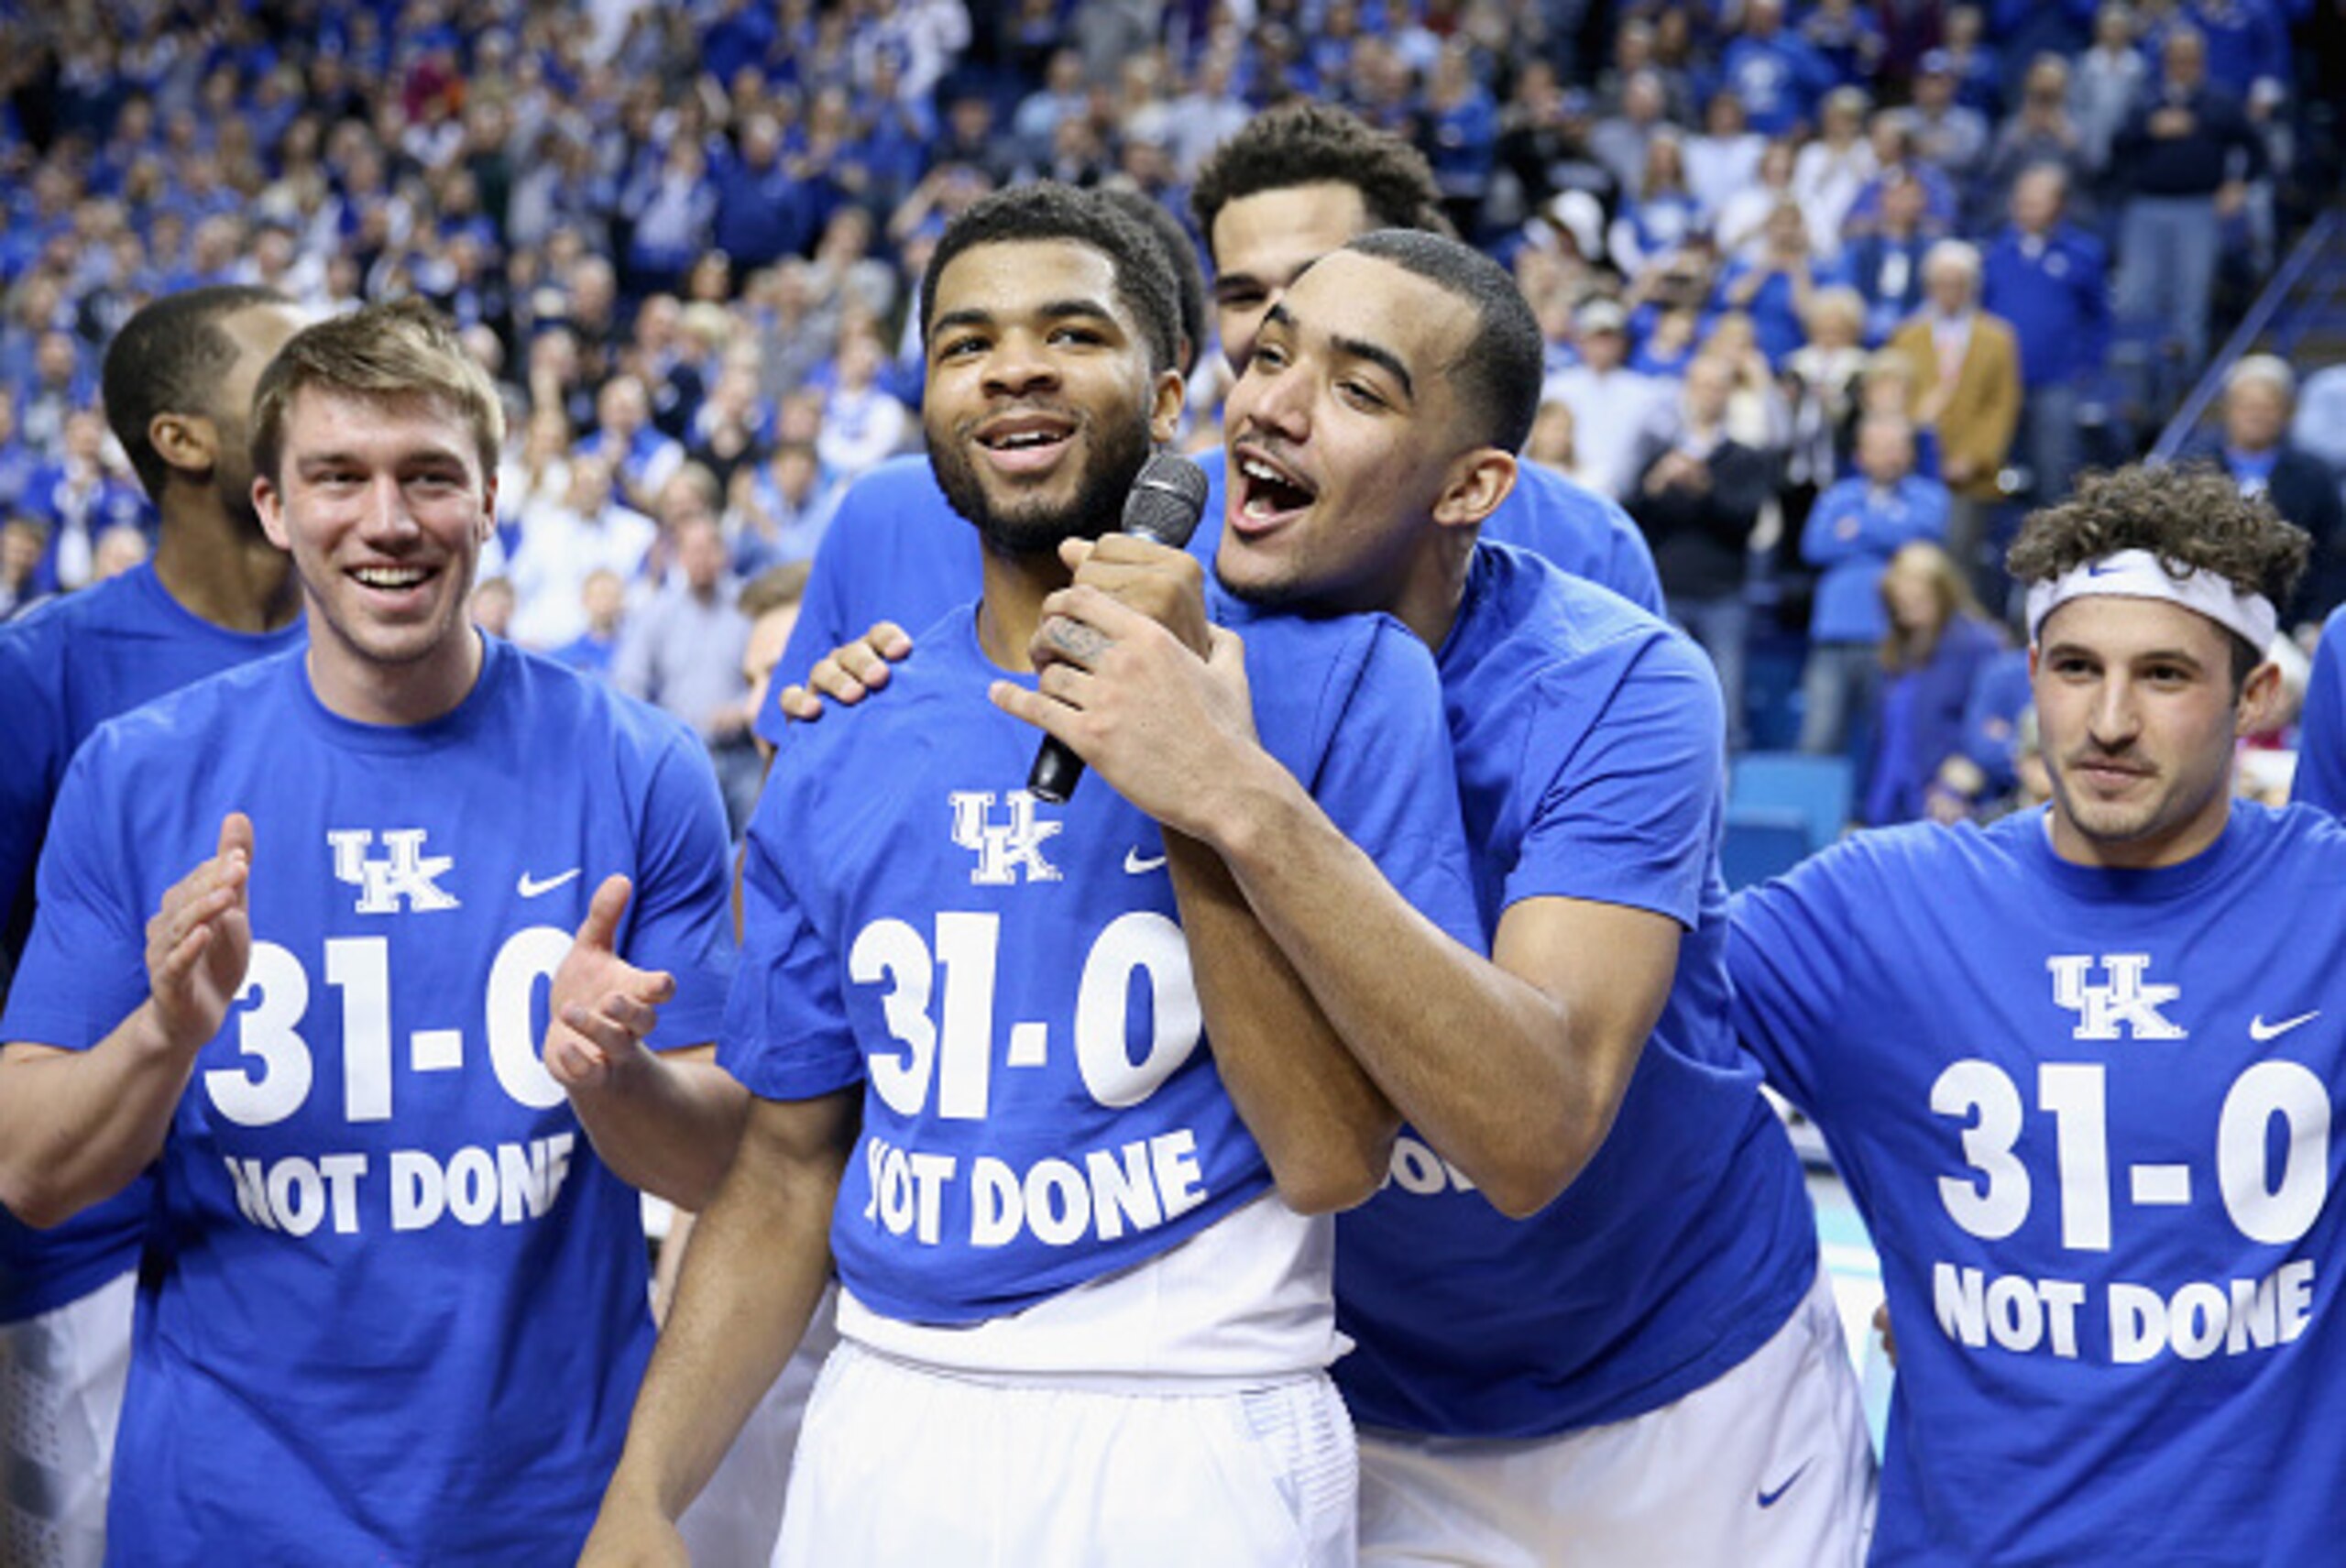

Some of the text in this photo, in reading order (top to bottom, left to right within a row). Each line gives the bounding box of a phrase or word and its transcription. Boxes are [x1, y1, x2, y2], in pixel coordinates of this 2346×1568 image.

[328, 829, 461, 914] UK
[948, 790, 1064, 885] UK
[849, 911, 1202, 1120] 31-0
[2047, 954, 2188, 1039] UK
[970, 1129, 1207, 1246] DONE
[1930, 1058, 2331, 1252] 31-0
[1934, 1259, 2314, 1364] NOT DONE
